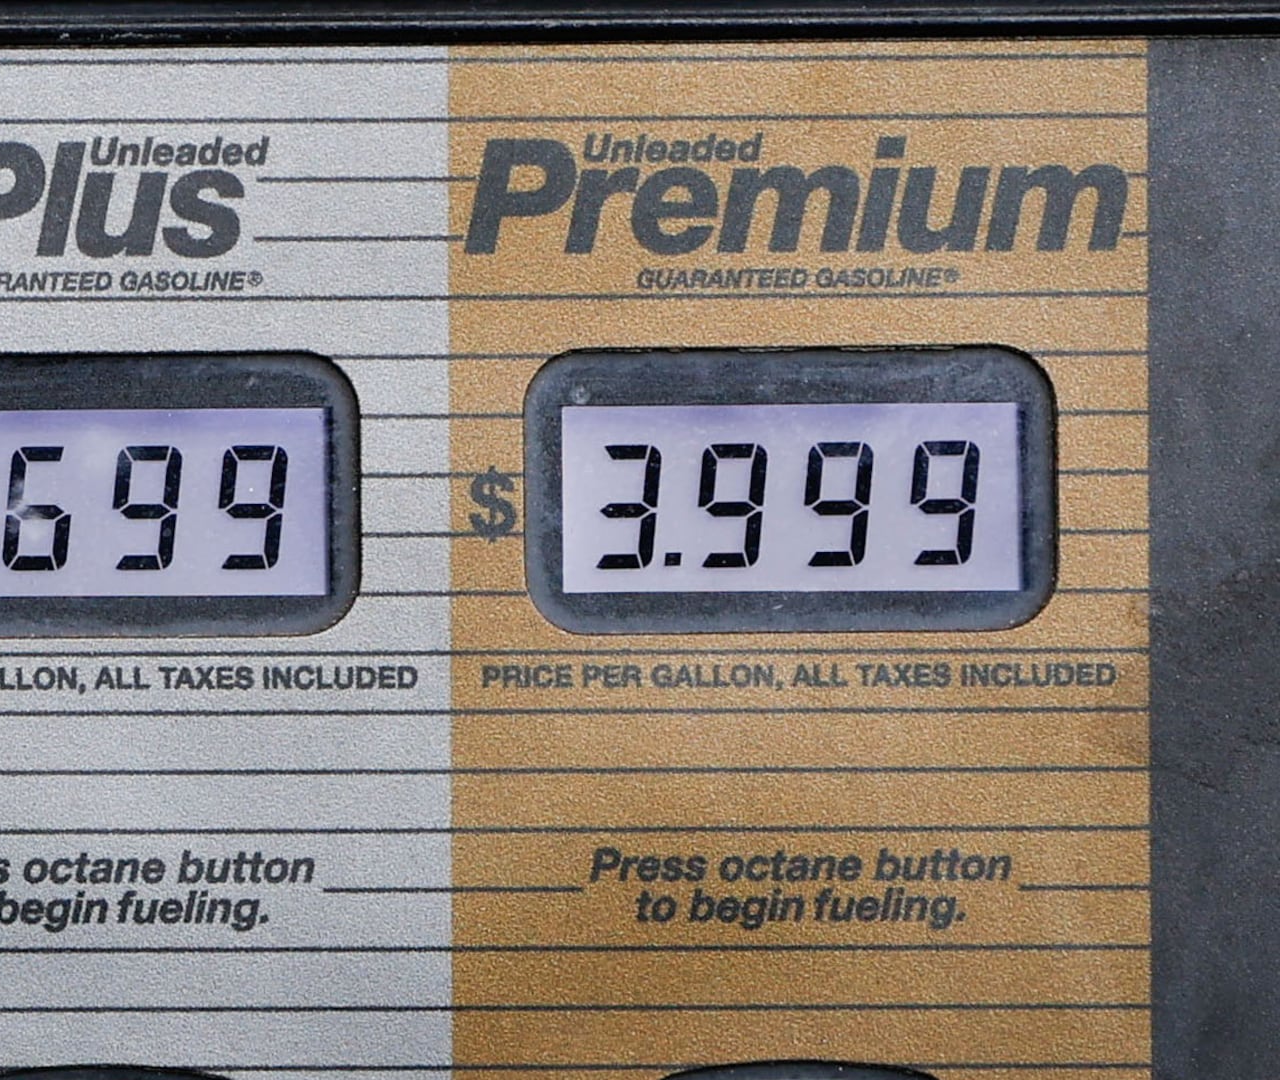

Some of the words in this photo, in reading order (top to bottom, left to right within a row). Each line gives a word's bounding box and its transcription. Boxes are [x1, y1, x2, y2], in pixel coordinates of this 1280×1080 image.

[90, 136, 270, 167] Unleaded
[583, 132, 763, 164] Unleaded
[463, 135, 1130, 255] Premium
[636, 268, 808, 290] GUARANTEED
[468, 466, 516, 543] $
[595, 439, 981, 570] 3.999
[94, 666, 151, 691] ALL
[158, 666, 255, 690] TAXES
[262, 665, 418, 690] INCLUDED
[482, 666, 573, 690] PRICE
[582, 665, 641, 689] PER
[650, 664, 783, 691] GALLON,
[790, 665, 848, 688] ALL
[856, 664, 952, 687] TAXES
[960, 662, 1117, 687] INCLUDED
[22, 852, 166, 885] octane
[178, 850, 315, 884] button
[589, 848, 707, 883] Press
[719, 850, 862, 882] octane
[873, 848, 1013, 881] button
[116, 893, 269, 931] fueling.
[636, 894, 677, 923] to
[688, 889, 804, 930] begin
[813, 890, 966, 929] fueling.
